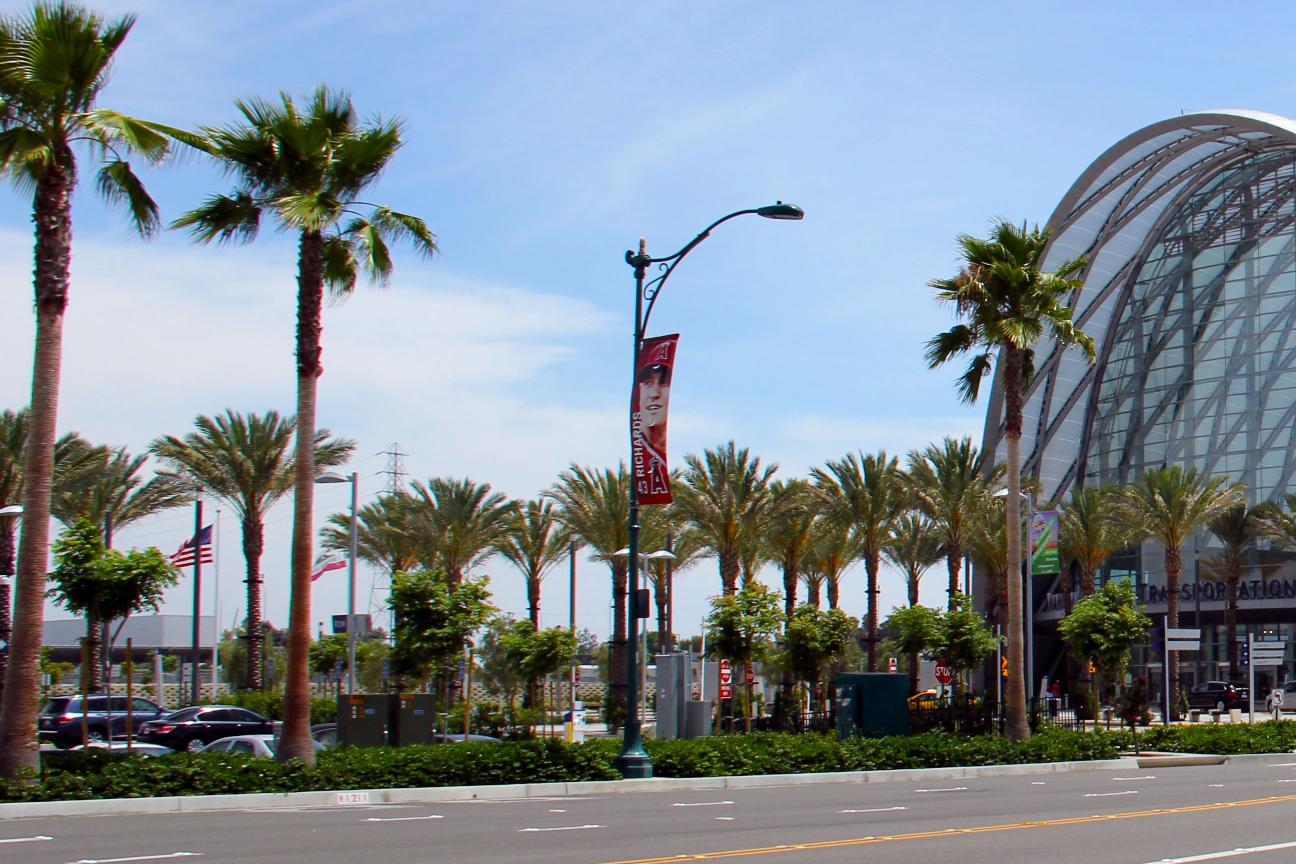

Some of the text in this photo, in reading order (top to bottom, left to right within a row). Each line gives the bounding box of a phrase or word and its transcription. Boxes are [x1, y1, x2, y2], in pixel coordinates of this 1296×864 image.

[632, 411, 646, 477] RICHARDS
[638, 481, 649, 494] 43
[651, 458, 669, 495] A
